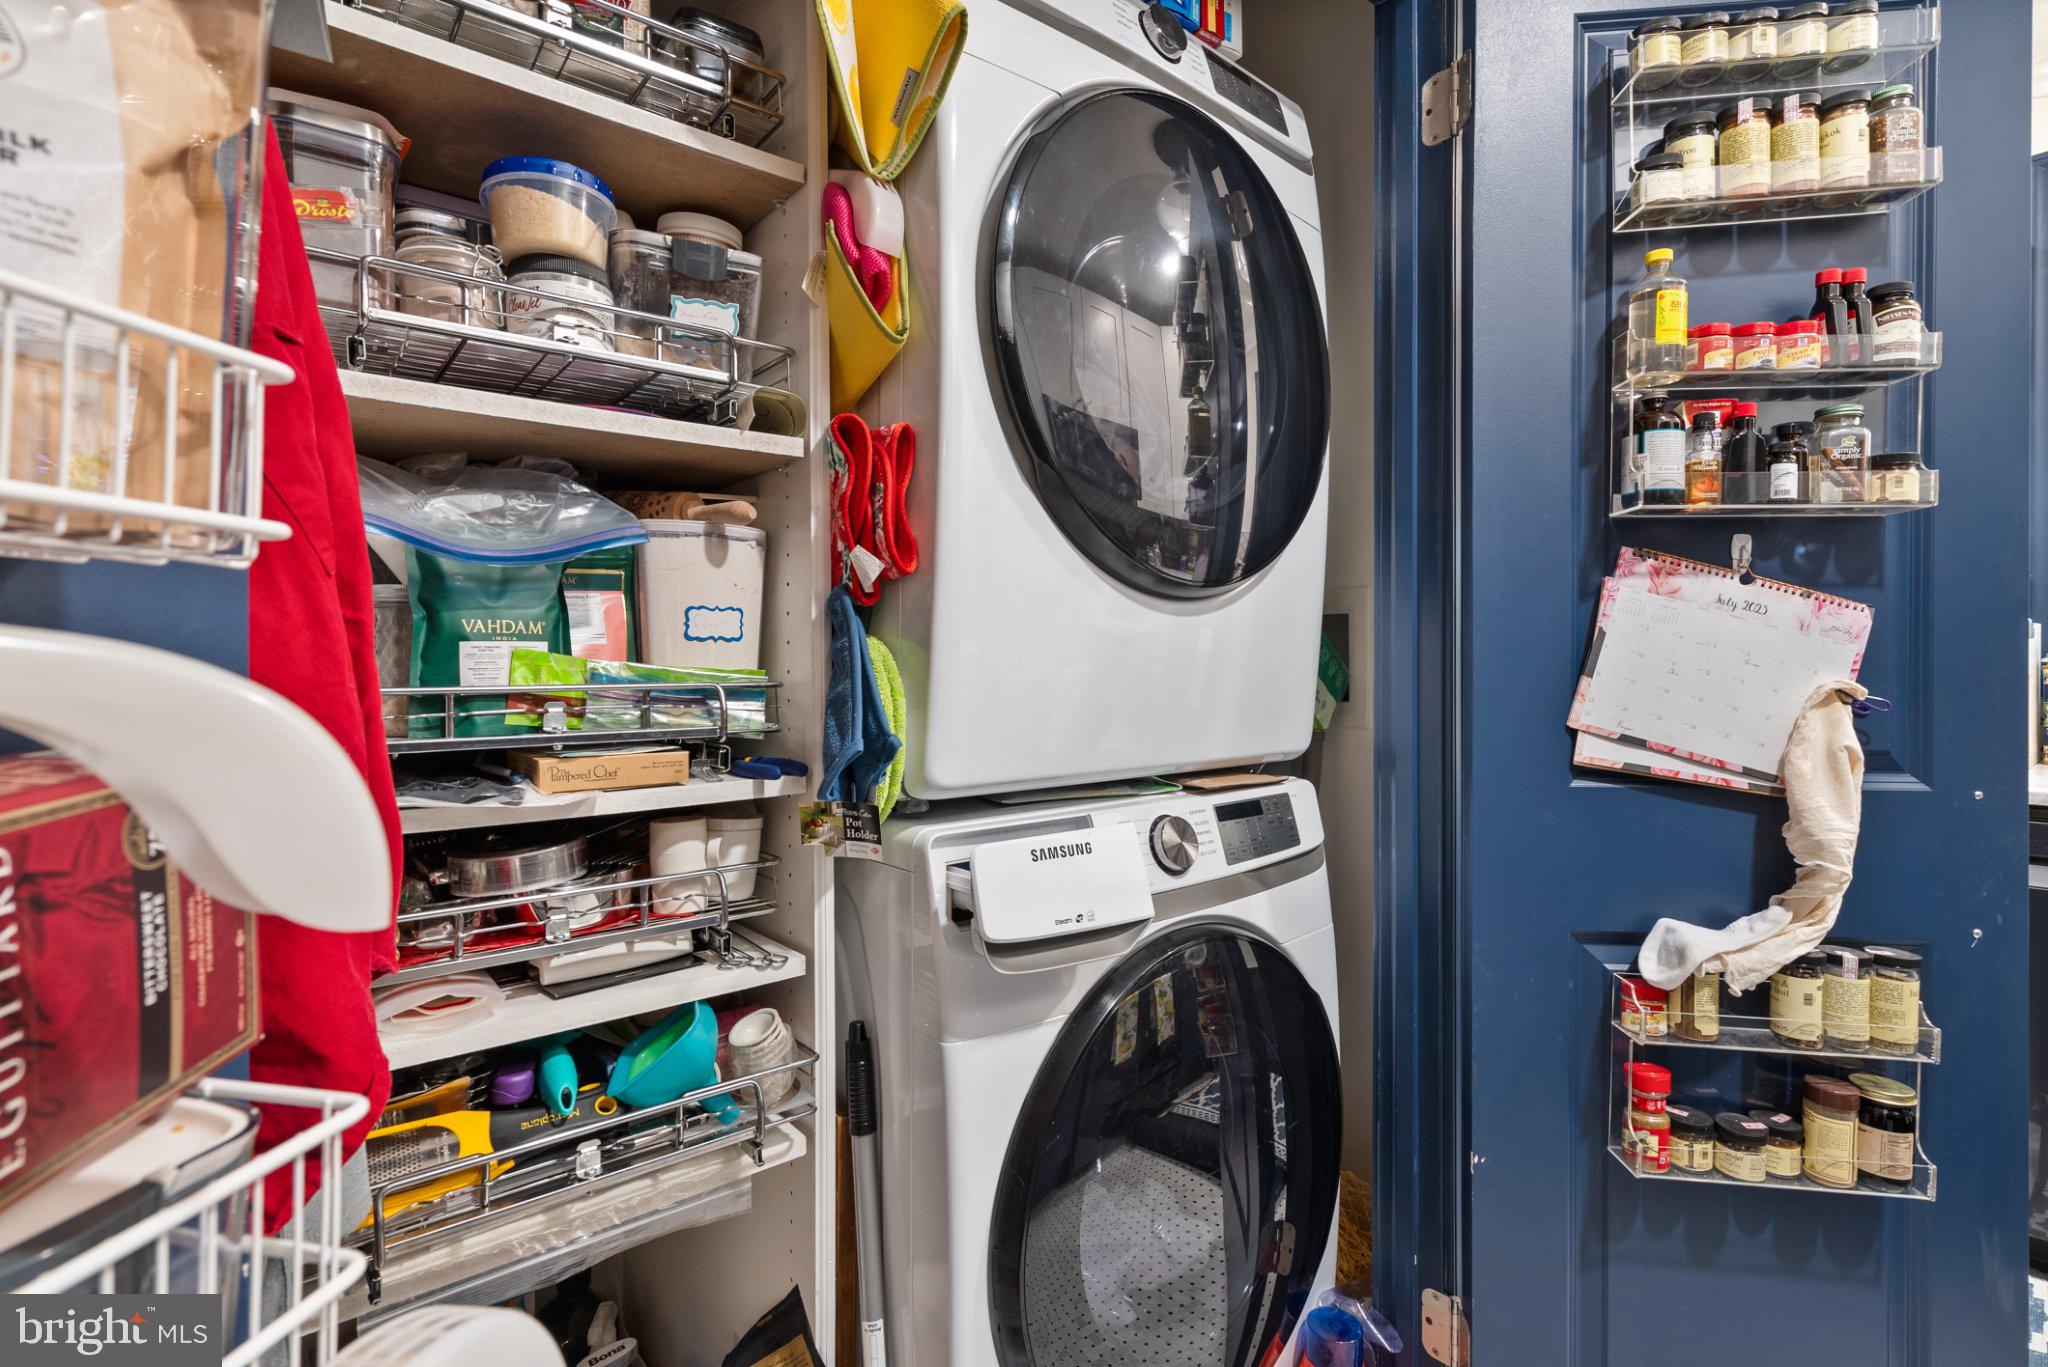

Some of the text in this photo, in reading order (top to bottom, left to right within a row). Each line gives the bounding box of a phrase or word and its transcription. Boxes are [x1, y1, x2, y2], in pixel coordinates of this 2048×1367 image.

[293, 199, 355, 218] Droste
[1831, 452, 1864, 460] Organic
[1833, 446, 1861, 459] Simply
[1742, 599, 1768, 615] 2023
[461, 618, 543, 635] VAHDAM
[547, 765, 591, 783] Pampered
[593, 764, 618, 779] Chef
[845, 817, 862, 829] Pot
[846, 828, 879, 842] Holder
[1030, 842, 1092, 862] SAMSUNG
[1054, 918, 1073, 926] Steam
[588, 1345, 626, 1366] Bona
